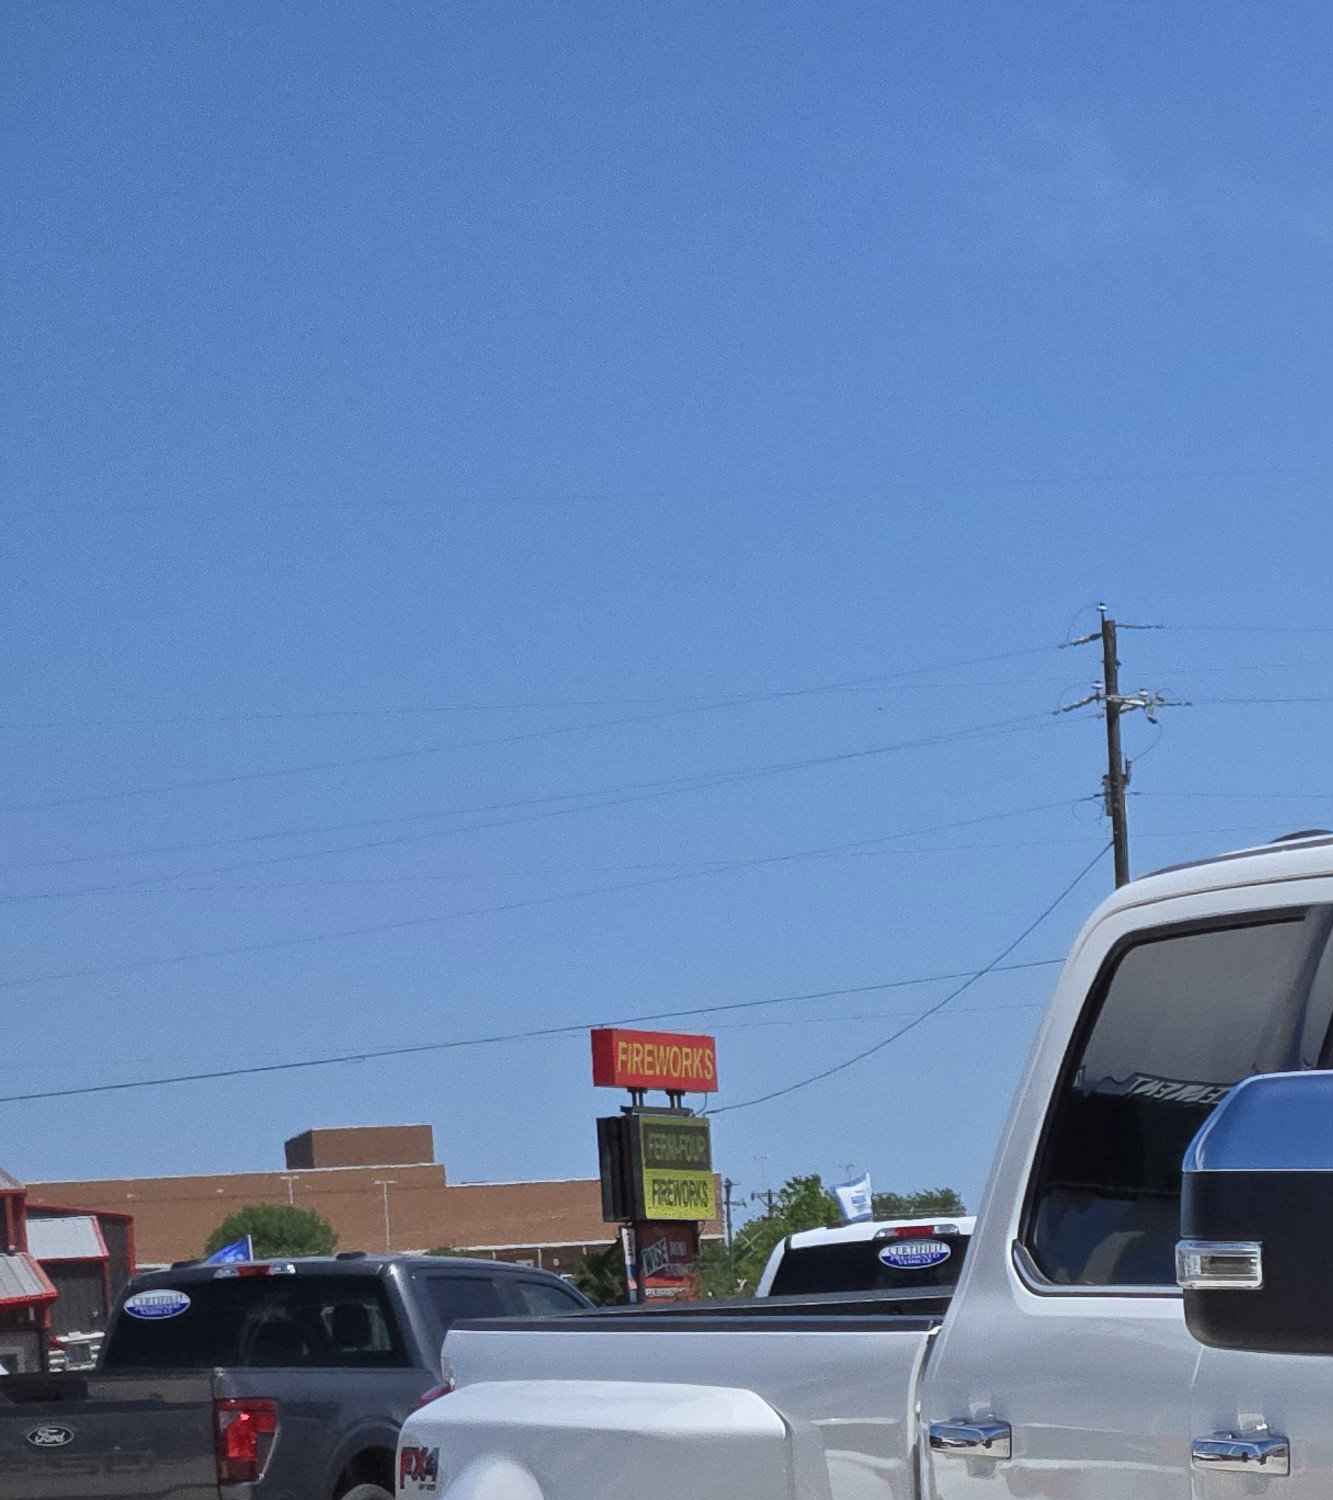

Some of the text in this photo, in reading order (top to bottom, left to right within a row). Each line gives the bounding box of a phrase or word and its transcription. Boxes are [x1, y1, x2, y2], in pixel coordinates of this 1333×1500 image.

[616, 1041, 714, 1080] FIREWORKS
[651, 1178, 709, 1208] FIREWORKS
[35, 1427, 65, 1443] Ford
[400, 1446, 440, 1490] FX4
